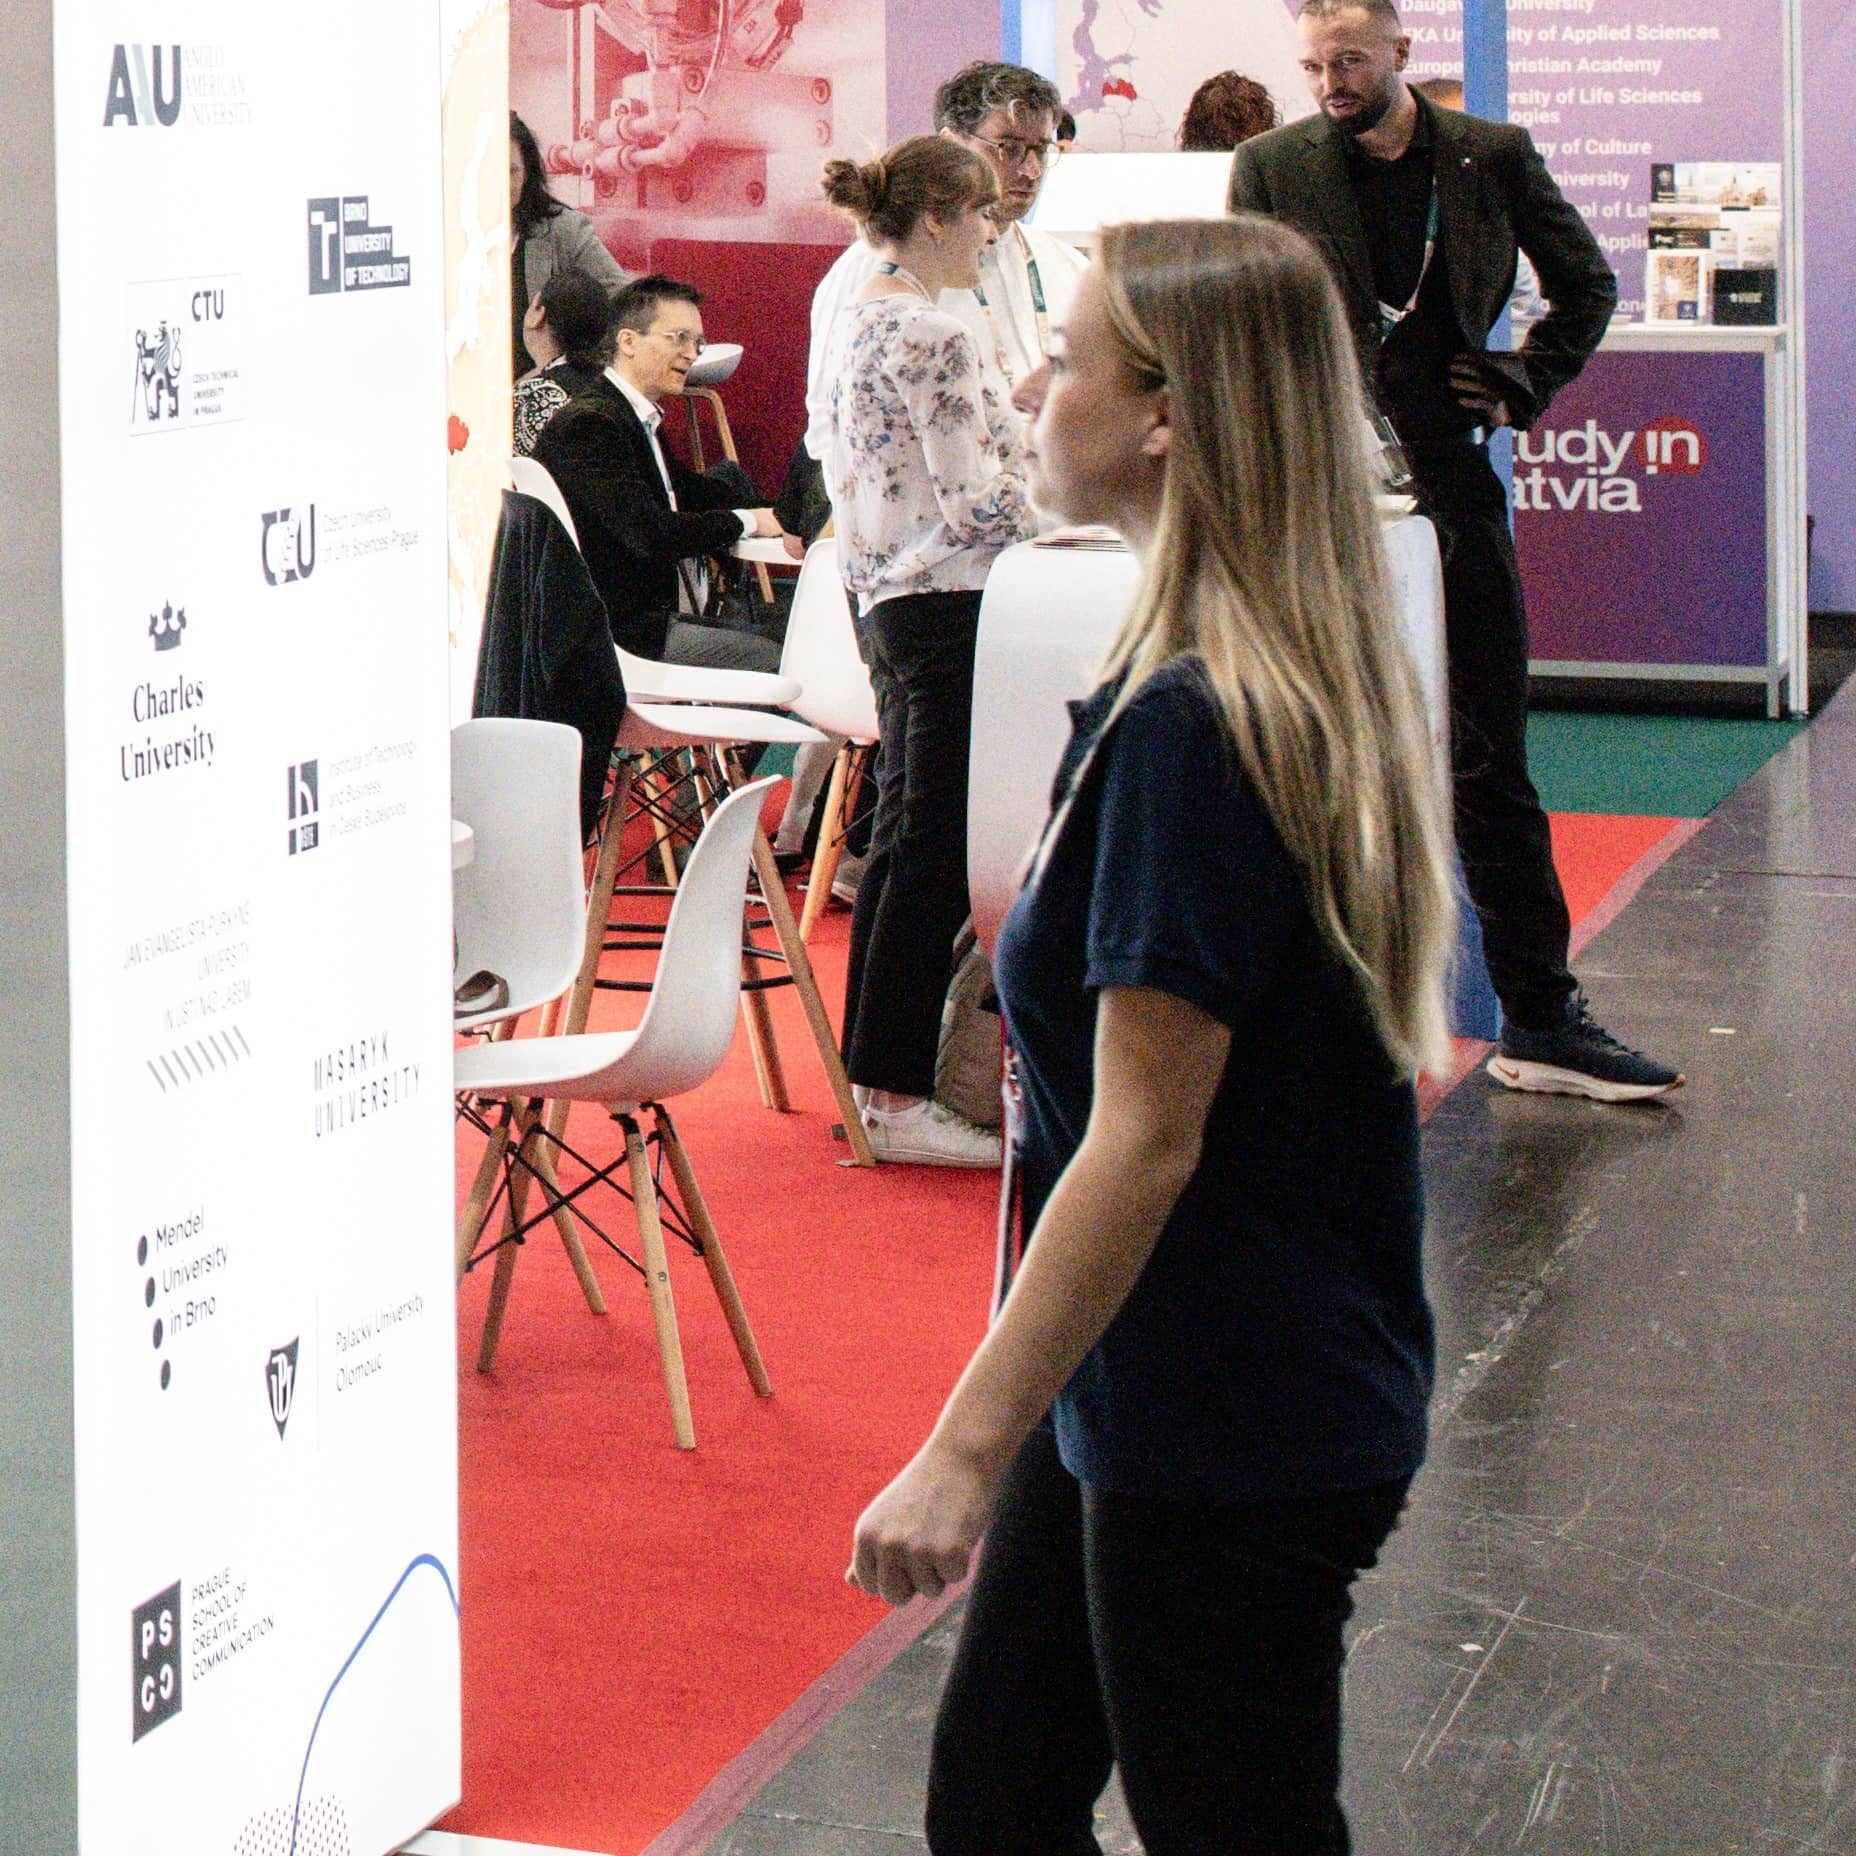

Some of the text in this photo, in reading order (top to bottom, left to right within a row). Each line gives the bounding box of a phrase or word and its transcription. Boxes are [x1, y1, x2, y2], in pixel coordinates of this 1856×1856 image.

[1539, 25, 1558, 42] of
[1560, 24, 1632, 45] Applied
[1635, 23, 1720, 41] Sciences
[1576, 57, 1663, 76] Academy
[1556, 89, 1576, 105] of
[1579, 88, 1615, 105] Life
[1619, 87, 1703, 105] Sciences
[1562, 138, 1580, 155] of
[1584, 138, 1653, 155] Culture
[1603, 202, 1621, 218] of
[191, 288, 224, 322] CTU
[132, 674, 204, 724] Charles
[120, 723, 216, 782] University
[314, 1030, 390, 1092] MASARYK
[315, 1063, 420, 1138] UNIVERSITY
[155, 1204, 204, 1253] Mendel
[162, 1241, 229, 1294] University
[169, 1295, 217, 1337] in Brno
[374, 1292, 425, 1335] University
[335, 1352, 384, 1393] Olomouc
[192, 1567, 231, 1604] PRAGUE
[192, 1581, 248, 1632] SCHOOL OF
[192, 1612, 239, 1657] CREATIVE
[192, 1614, 276, 1682] COMMUNICATION
